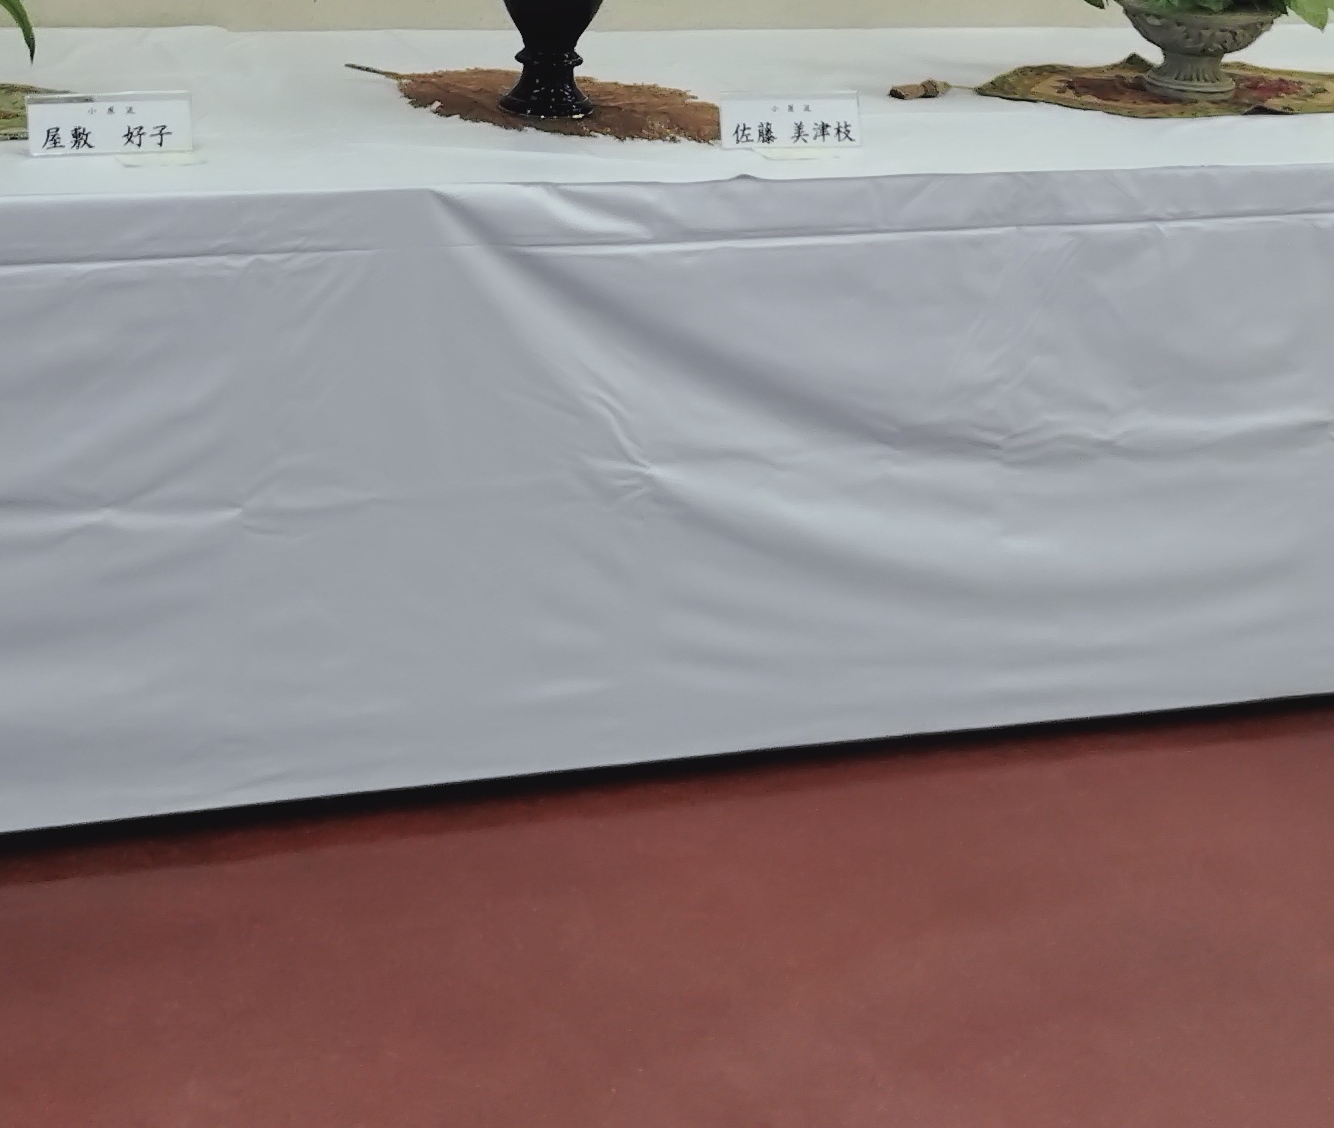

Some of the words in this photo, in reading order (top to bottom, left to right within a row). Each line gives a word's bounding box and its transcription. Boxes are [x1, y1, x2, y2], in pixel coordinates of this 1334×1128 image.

[42, 126, 95, 150] 屋敷
[122, 125, 173, 148] 好子
[732, 122, 778, 144] 佐藤
[791, 121, 856, 144] 美津枝
